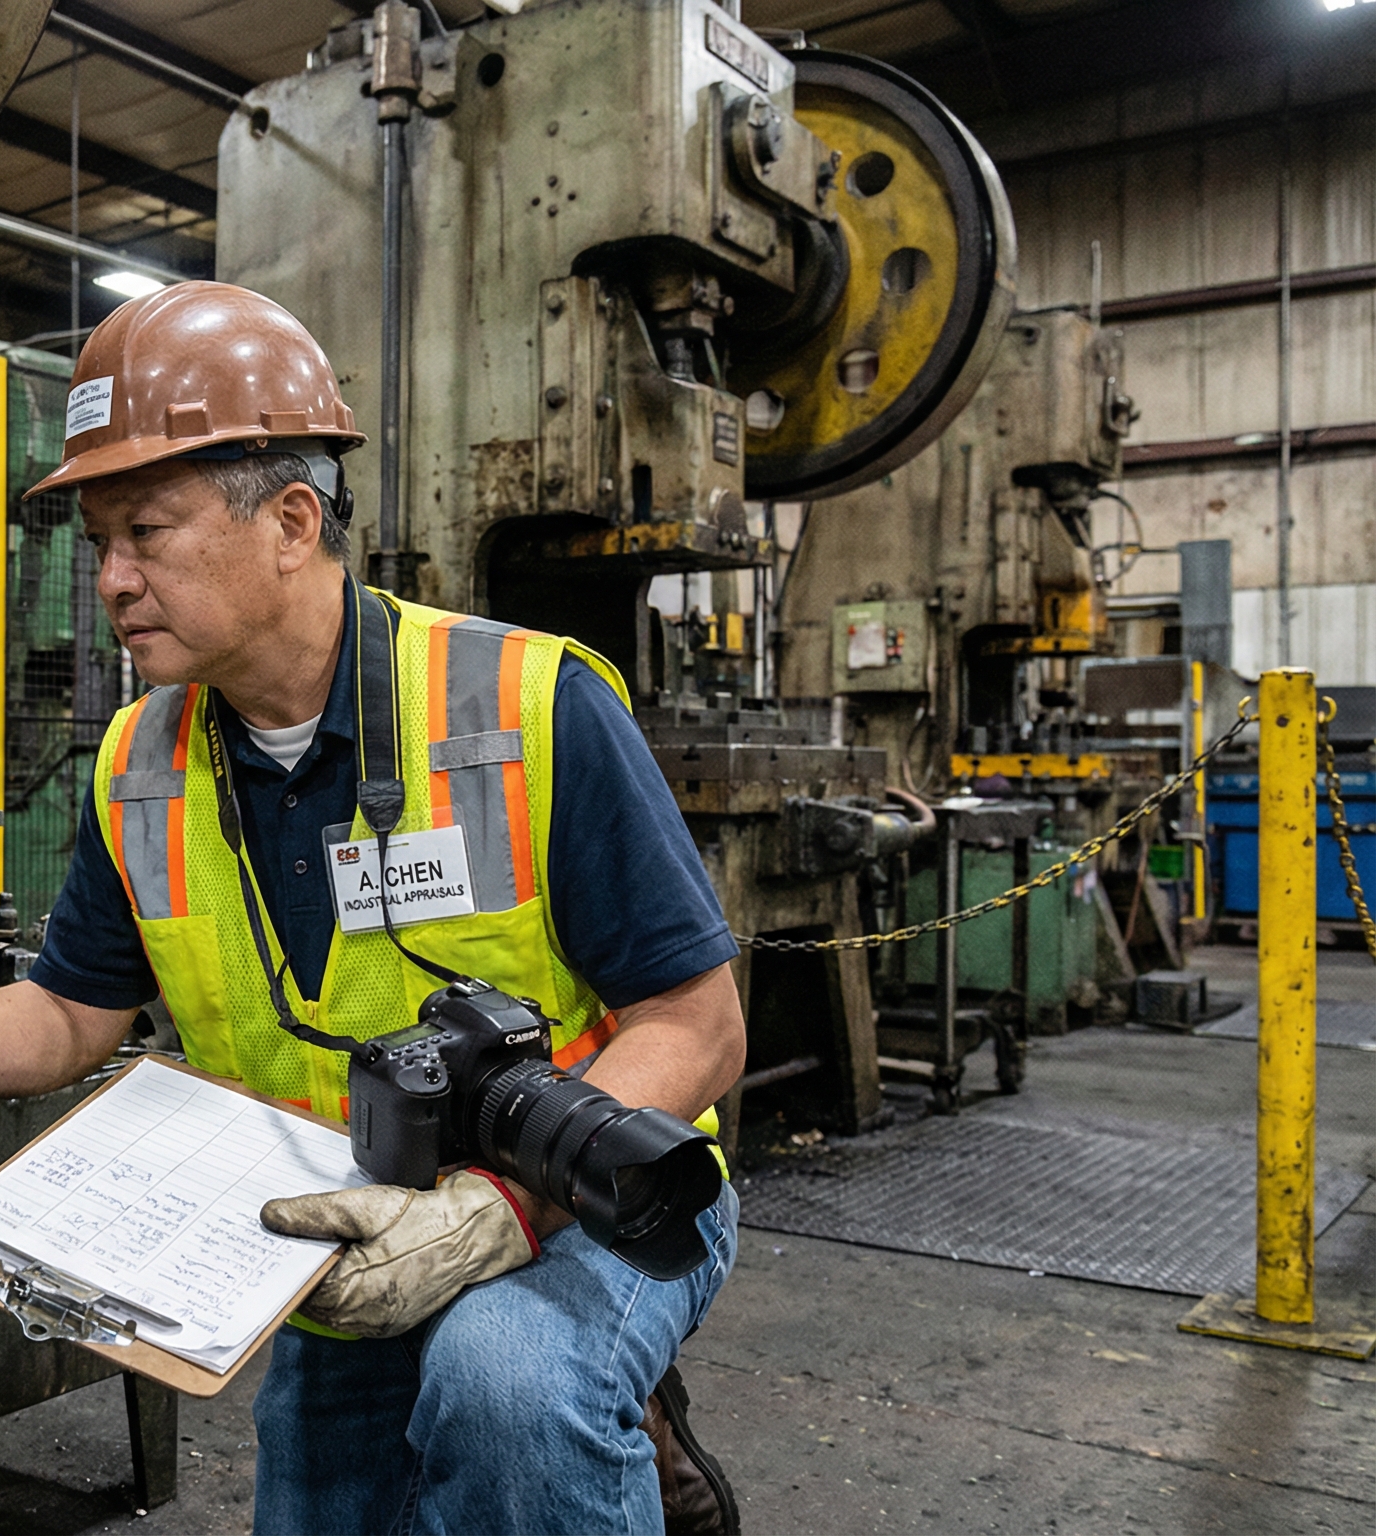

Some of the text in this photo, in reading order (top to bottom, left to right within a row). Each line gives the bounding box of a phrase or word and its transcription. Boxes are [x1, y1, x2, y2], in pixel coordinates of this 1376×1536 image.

[359, 860, 443, 892] A. CHEN
[344, 884, 464, 912] INDUSTAL APPRAISALS
